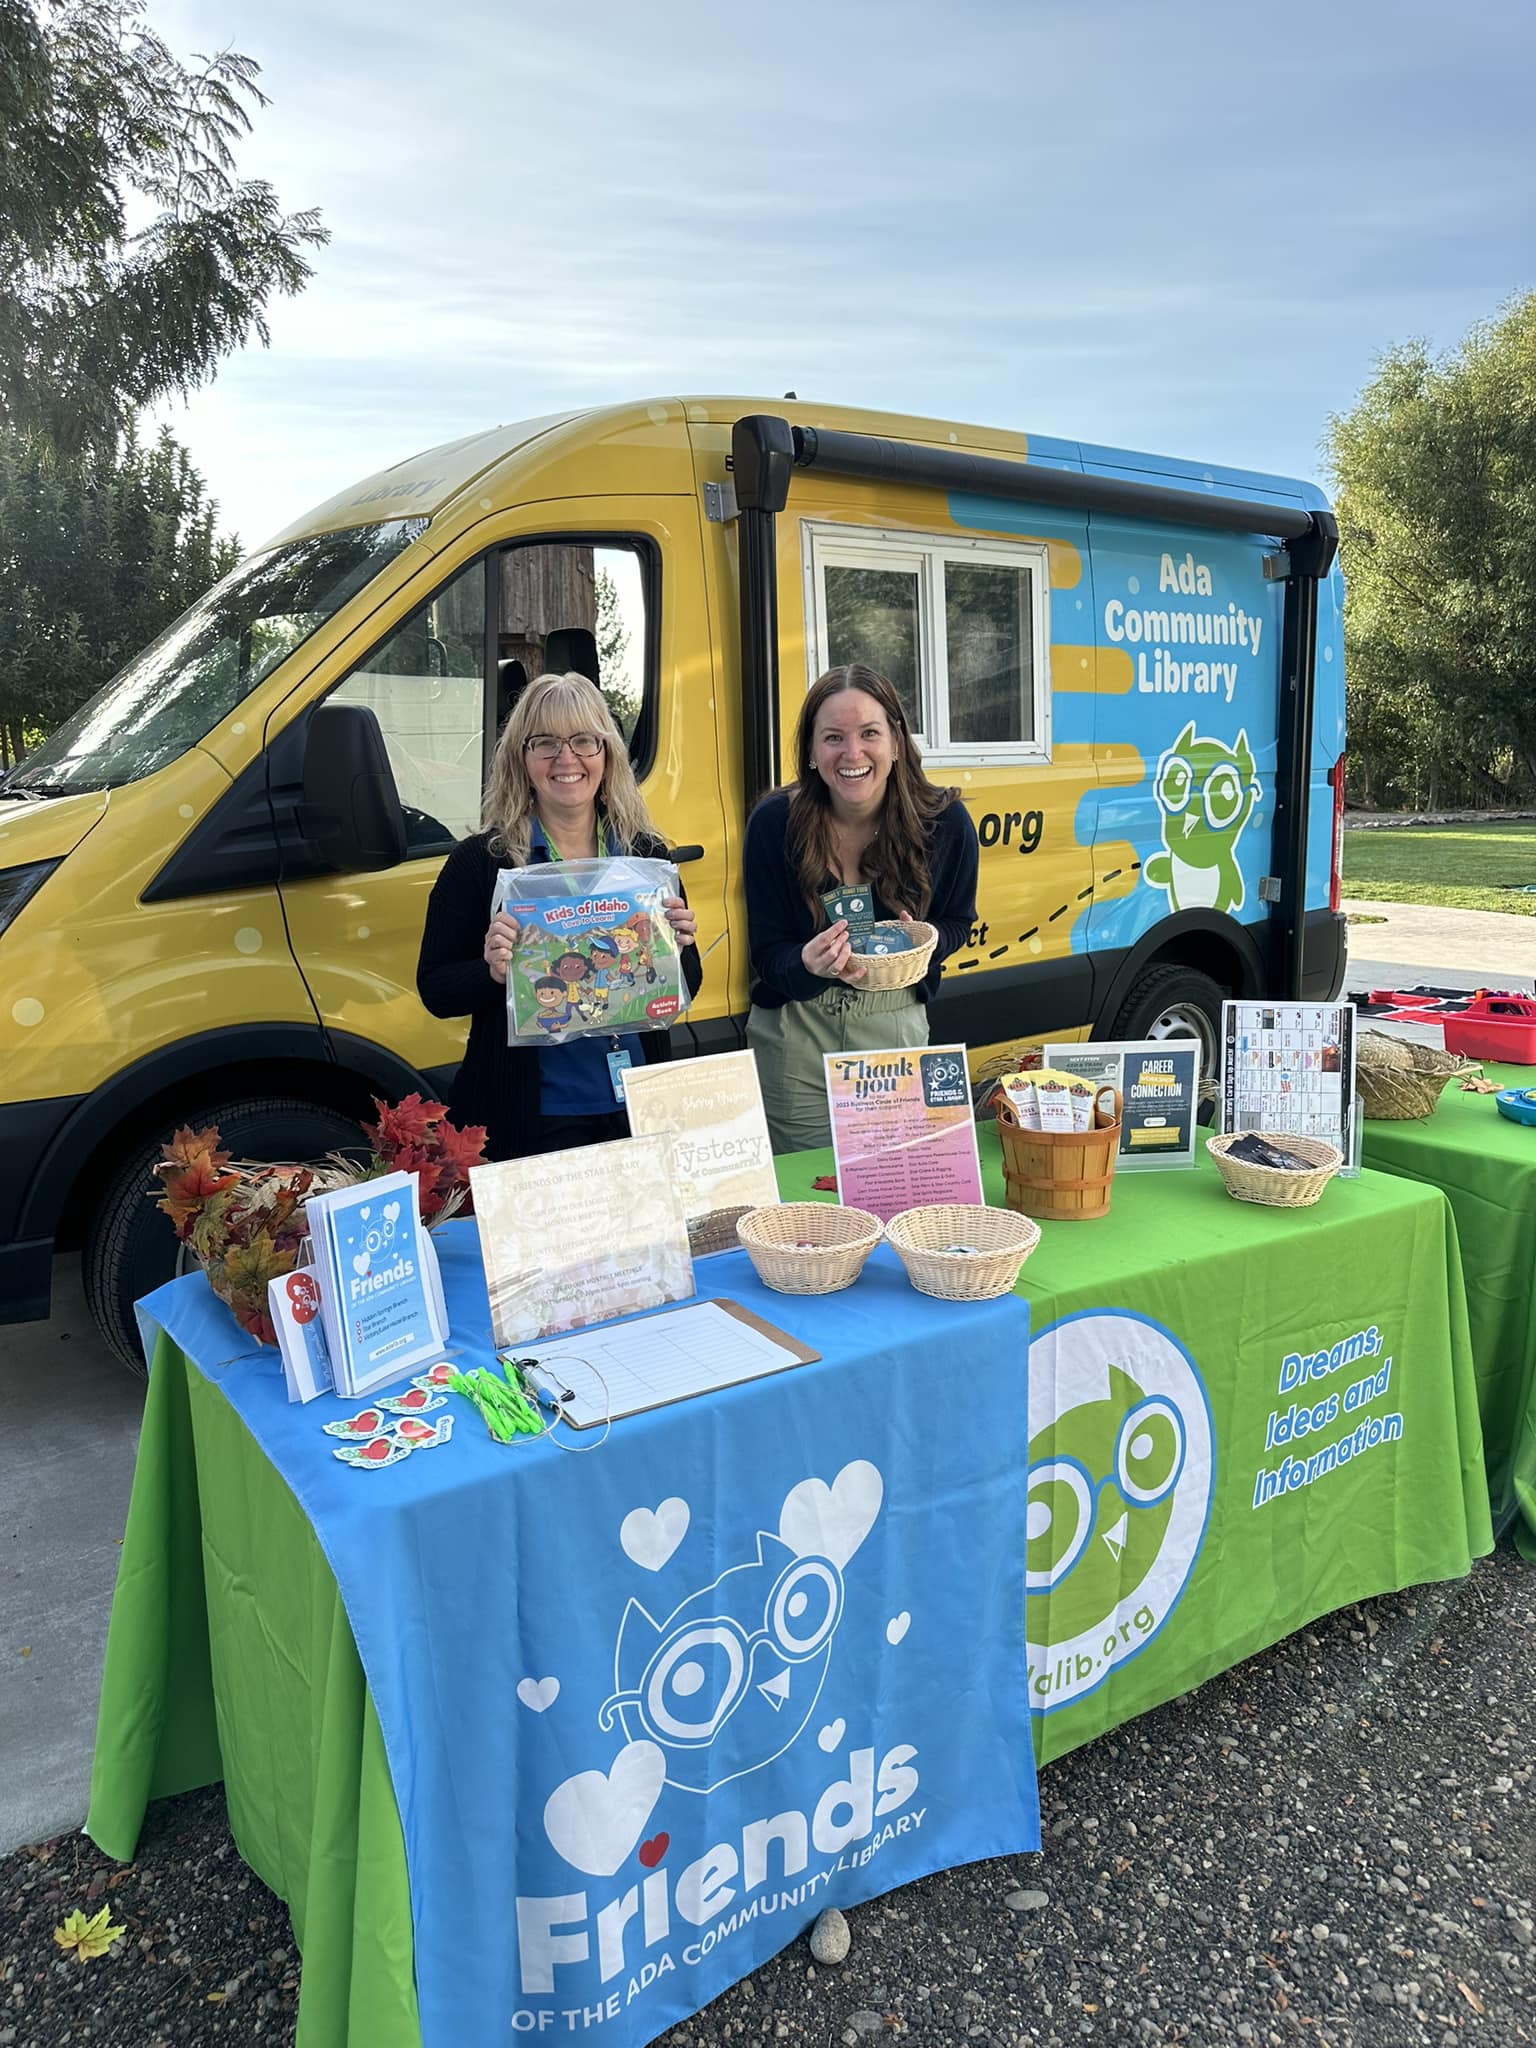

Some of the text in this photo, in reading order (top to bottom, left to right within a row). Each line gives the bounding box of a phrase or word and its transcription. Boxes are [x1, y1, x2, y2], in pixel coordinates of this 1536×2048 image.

[1159, 552, 1213, 596] Ada
[1104, 599, 1262, 656] Community
[1138, 648, 1238, 703] Library
[545, 905, 574, 924] Kids
[577, 900, 592, 916] of
[594, 898, 630, 914] Idaho
[652, 1000, 677, 1009] Activity
[835, 1057, 913, 1080] Thank
[855, 1078, 896, 1099] you
[1142, 1060, 1174, 1074] CAREER
[1131, 1082, 1182, 1098] CONNECTION
[1227, 1086, 1236, 1098] Card
[513, 1177, 552, 1193] FRIENDS
[552, 1174, 564, 1185] OF
[567, 1171, 584, 1182] THE
[584, 1166, 606, 1178] STAR
[350, 1258, 414, 1301] Friends
[1278, 1325, 1384, 1394] Dreams,
[1264, 1357, 1392, 1452] Ideas and
[1252, 1412, 1404, 1510] Information
[1028, 1602, 1156, 1696] alib.org
[515, 1744, 920, 1995] Friends
[511, 1807, 927, 2032] OF THE ADA COMMUNITY LIBRARY
